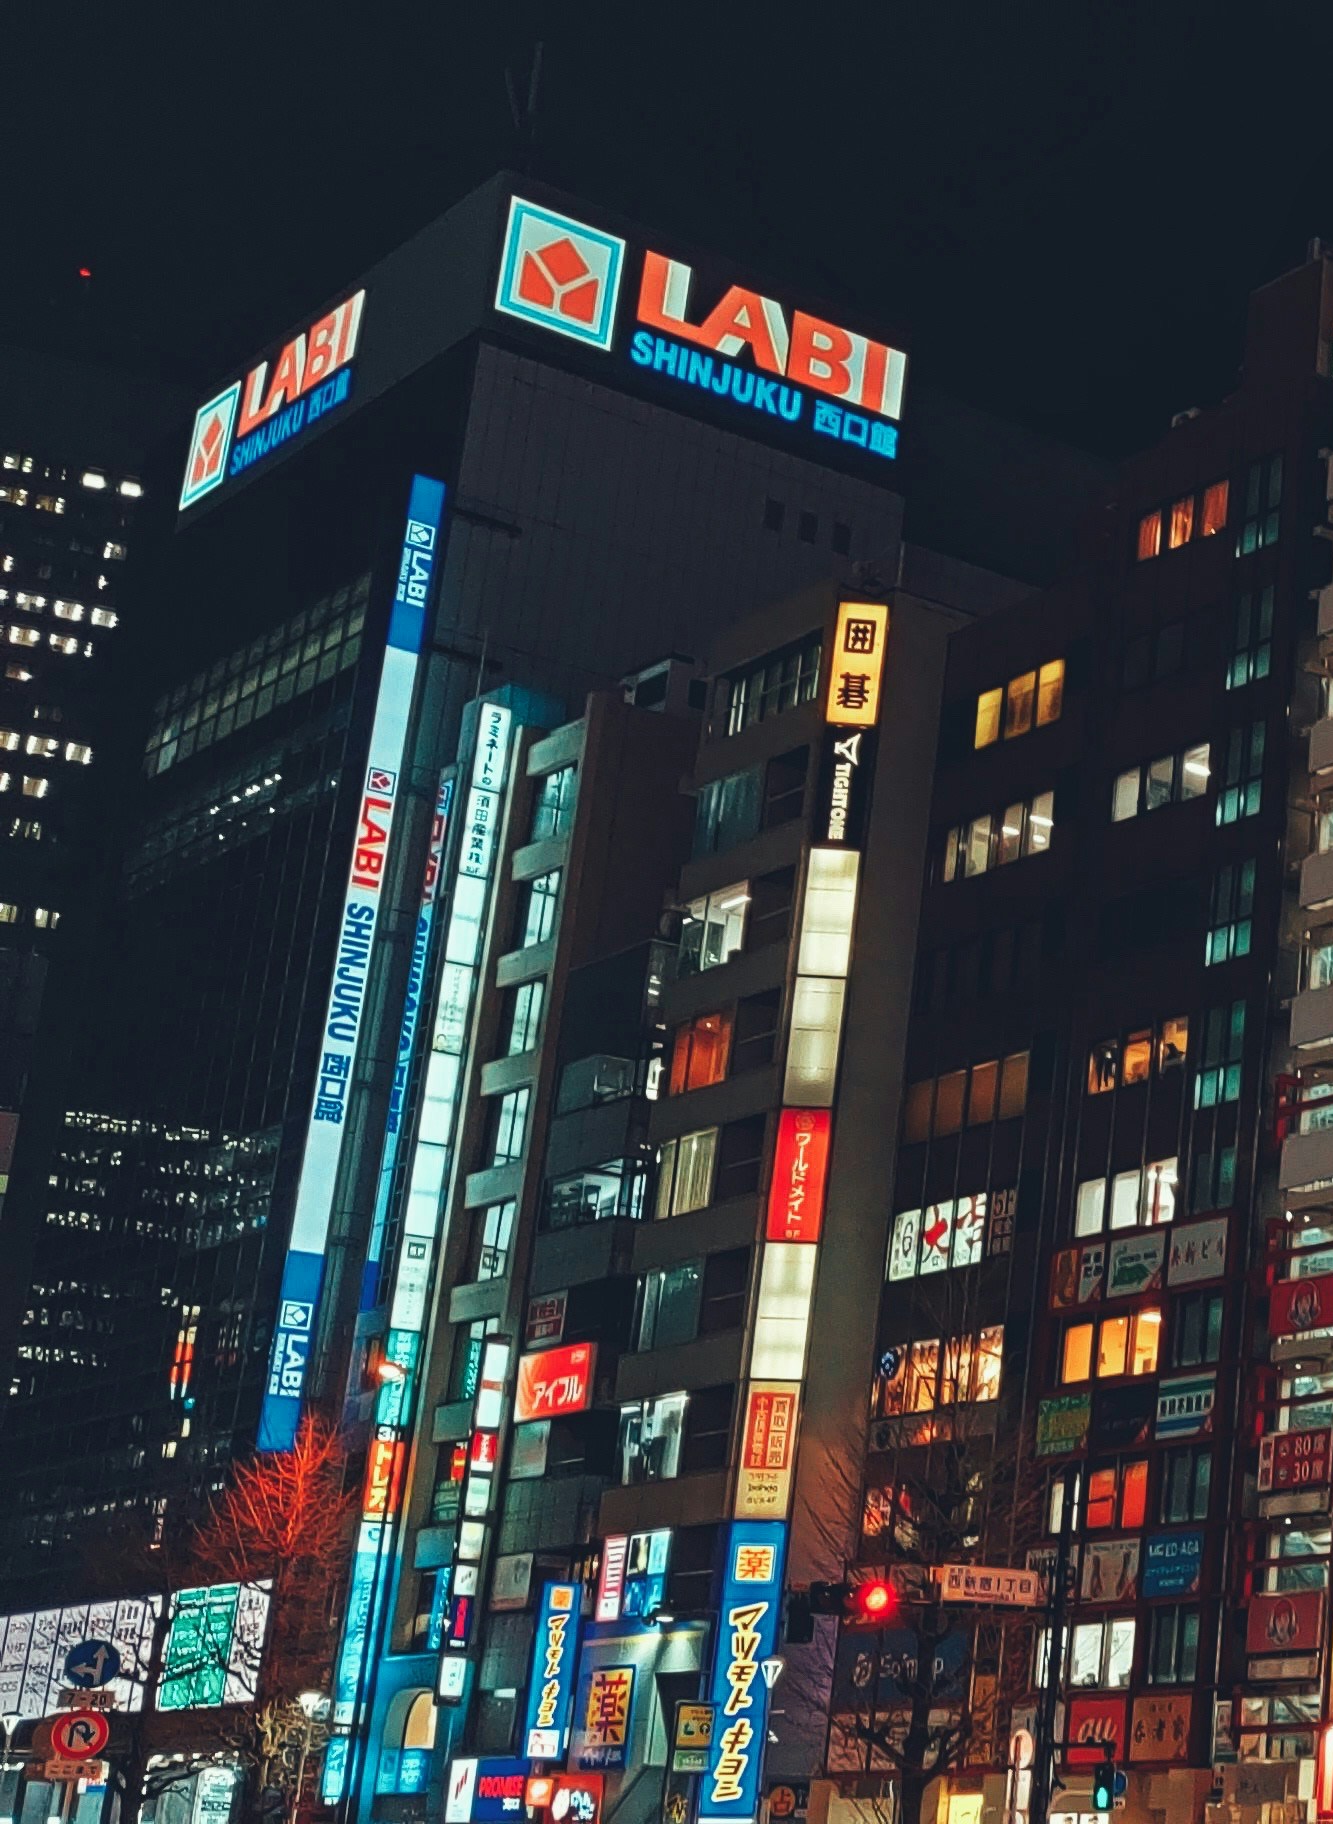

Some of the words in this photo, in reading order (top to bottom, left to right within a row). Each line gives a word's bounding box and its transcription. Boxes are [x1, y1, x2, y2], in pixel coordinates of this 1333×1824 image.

[236, 289, 365, 438] LABI
[637, 250, 906, 420] LABI
[230, 400, 303, 476] SHINJUKU
[631, 330, 803, 421] SHINJUKU
[813, 400, 898, 459] 西口館
[405, 551, 432, 607] LABI
[836, 618, 877, 710] 囲碁
[352, 799, 392, 888] LABI
[327, 902, 376, 1044] SHINJUKU
[314, 1053, 350, 1126] 西口館
[788, 1133, 810, 1226] ワールドメイト
[281, 1335, 309, 1398] LABI
[532, 1374, 583, 1411] アイフル
[739, 1549, 771, 1578] 薬
[537, 1614, 570, 1727] マツモトキヨシ
[589, 1671, 628, 1745] 薬
[711, 1601, 769, 1802] マツモトキヨシ
[479, 1775, 525, 1797] PROMISE
